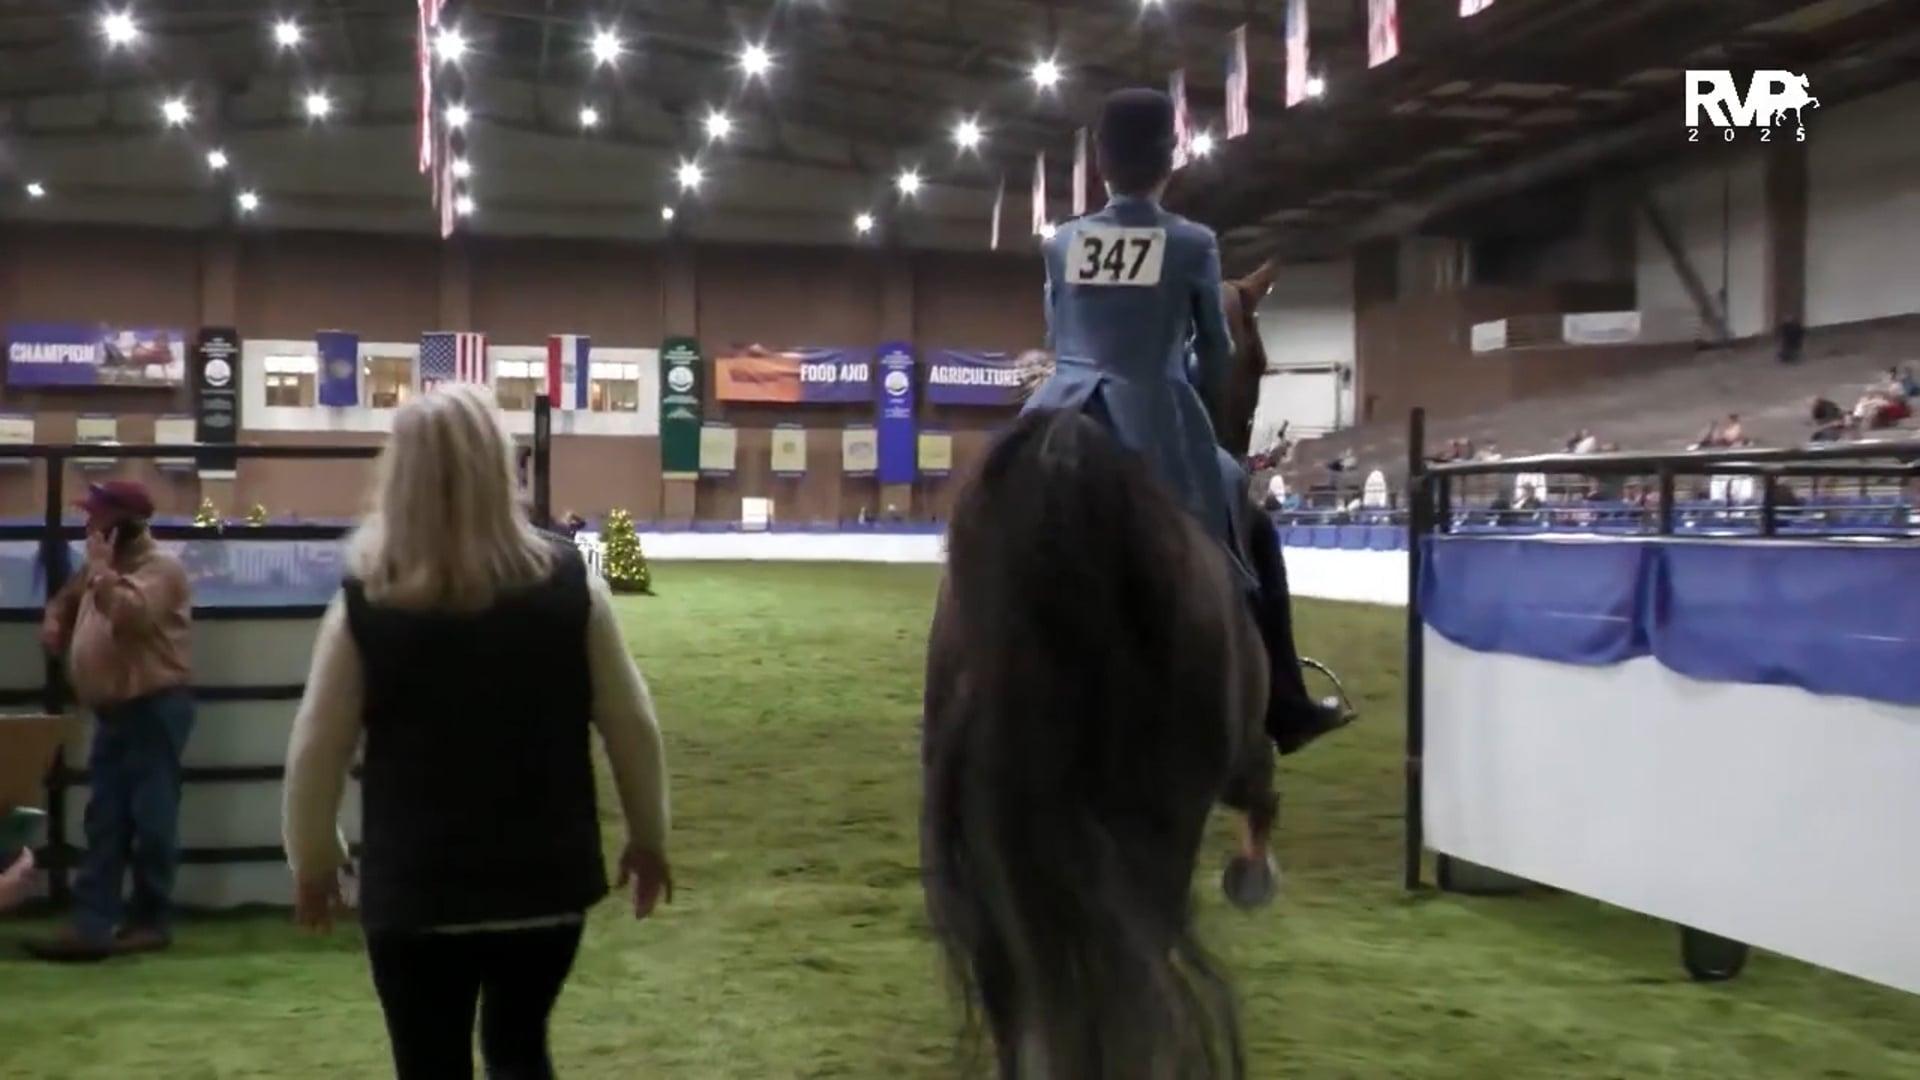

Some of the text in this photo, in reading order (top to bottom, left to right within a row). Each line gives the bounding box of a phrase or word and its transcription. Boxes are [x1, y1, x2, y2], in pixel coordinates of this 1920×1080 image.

[1079, 236, 1152, 281] 347
[9, 342, 95, 363] CHAMPION
[800, 363, 869, 382] FOOD AND
[929, 365, 1021, 386] AGRICULTURE
